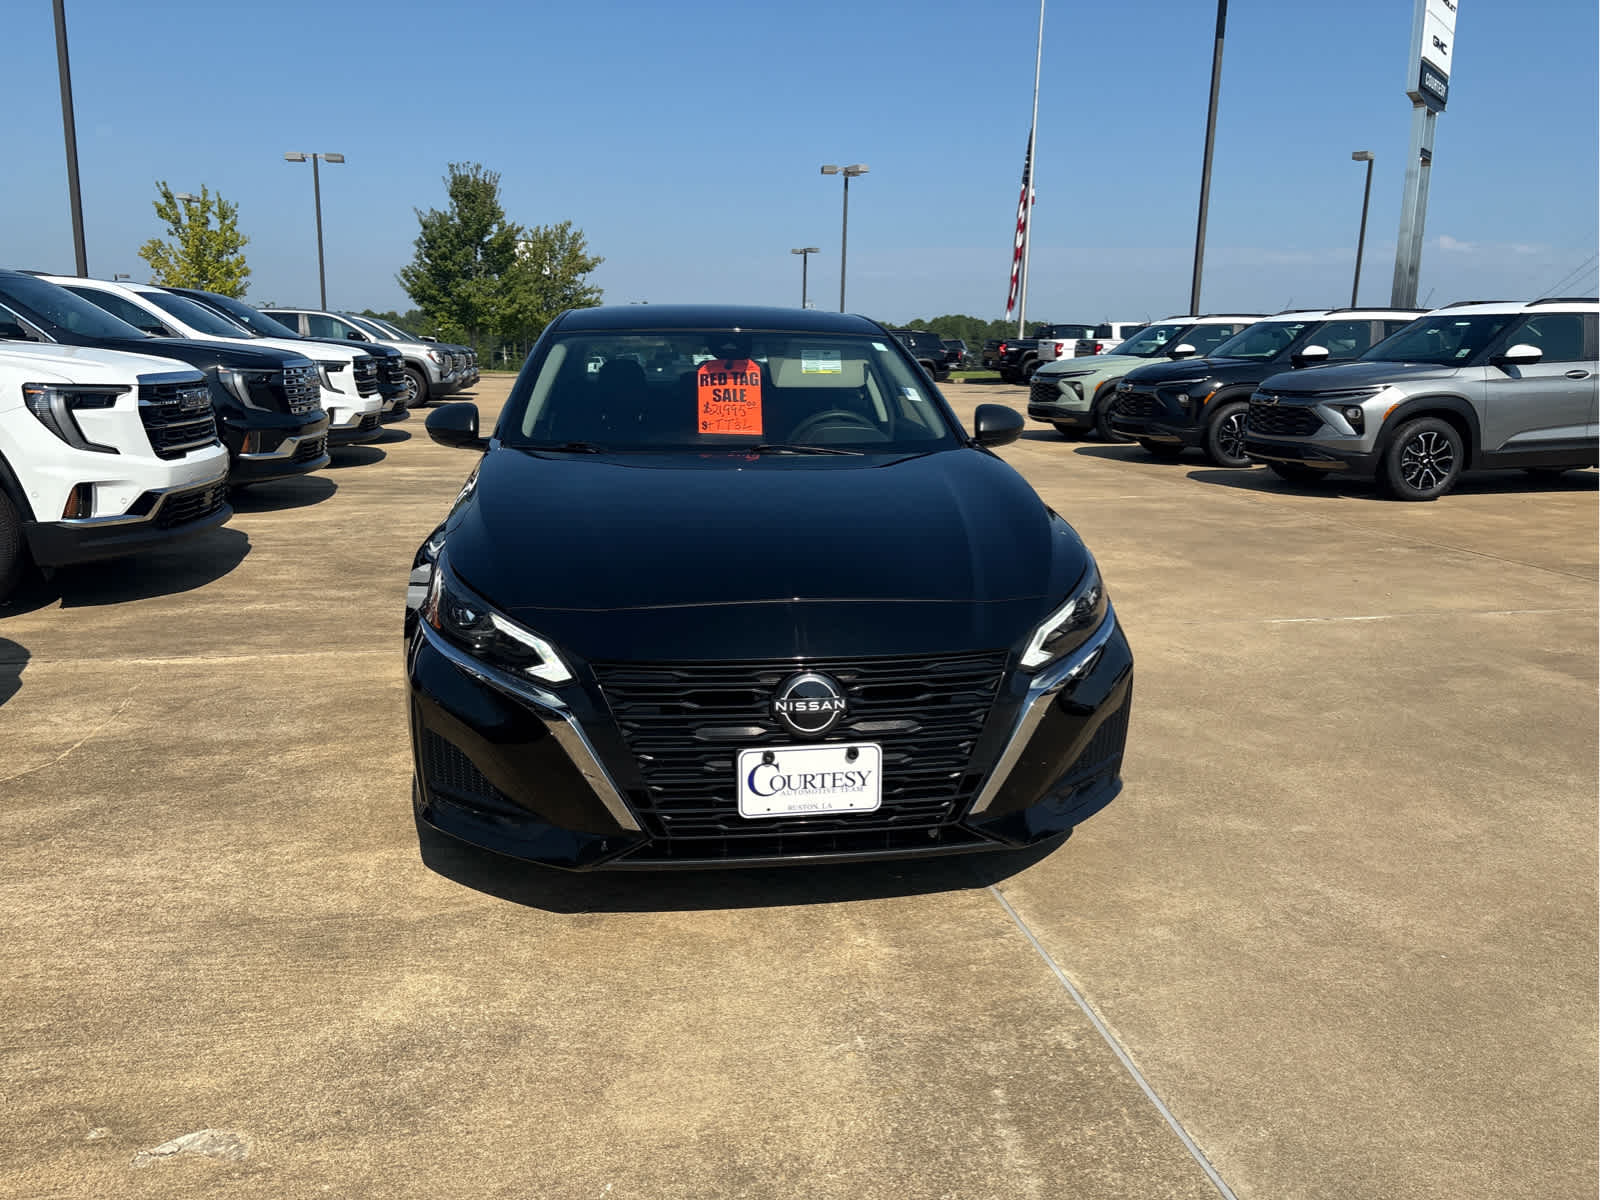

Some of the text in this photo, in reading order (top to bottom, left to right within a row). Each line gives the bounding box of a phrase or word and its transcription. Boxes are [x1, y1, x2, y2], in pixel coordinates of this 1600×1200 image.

[1433, 34, 1447, 55] GMC
[1425, 73, 1446, 97] COURTESY
[700, 371, 760, 387] RED TAG
[712, 388, 747, 402] SALE
[775, 699, 846, 712] NISSAN
[747, 762, 873, 797] COURTESY
[781, 785, 864, 796] AUTOMOTIVE TEAM
[822, 802, 833, 810] LA
